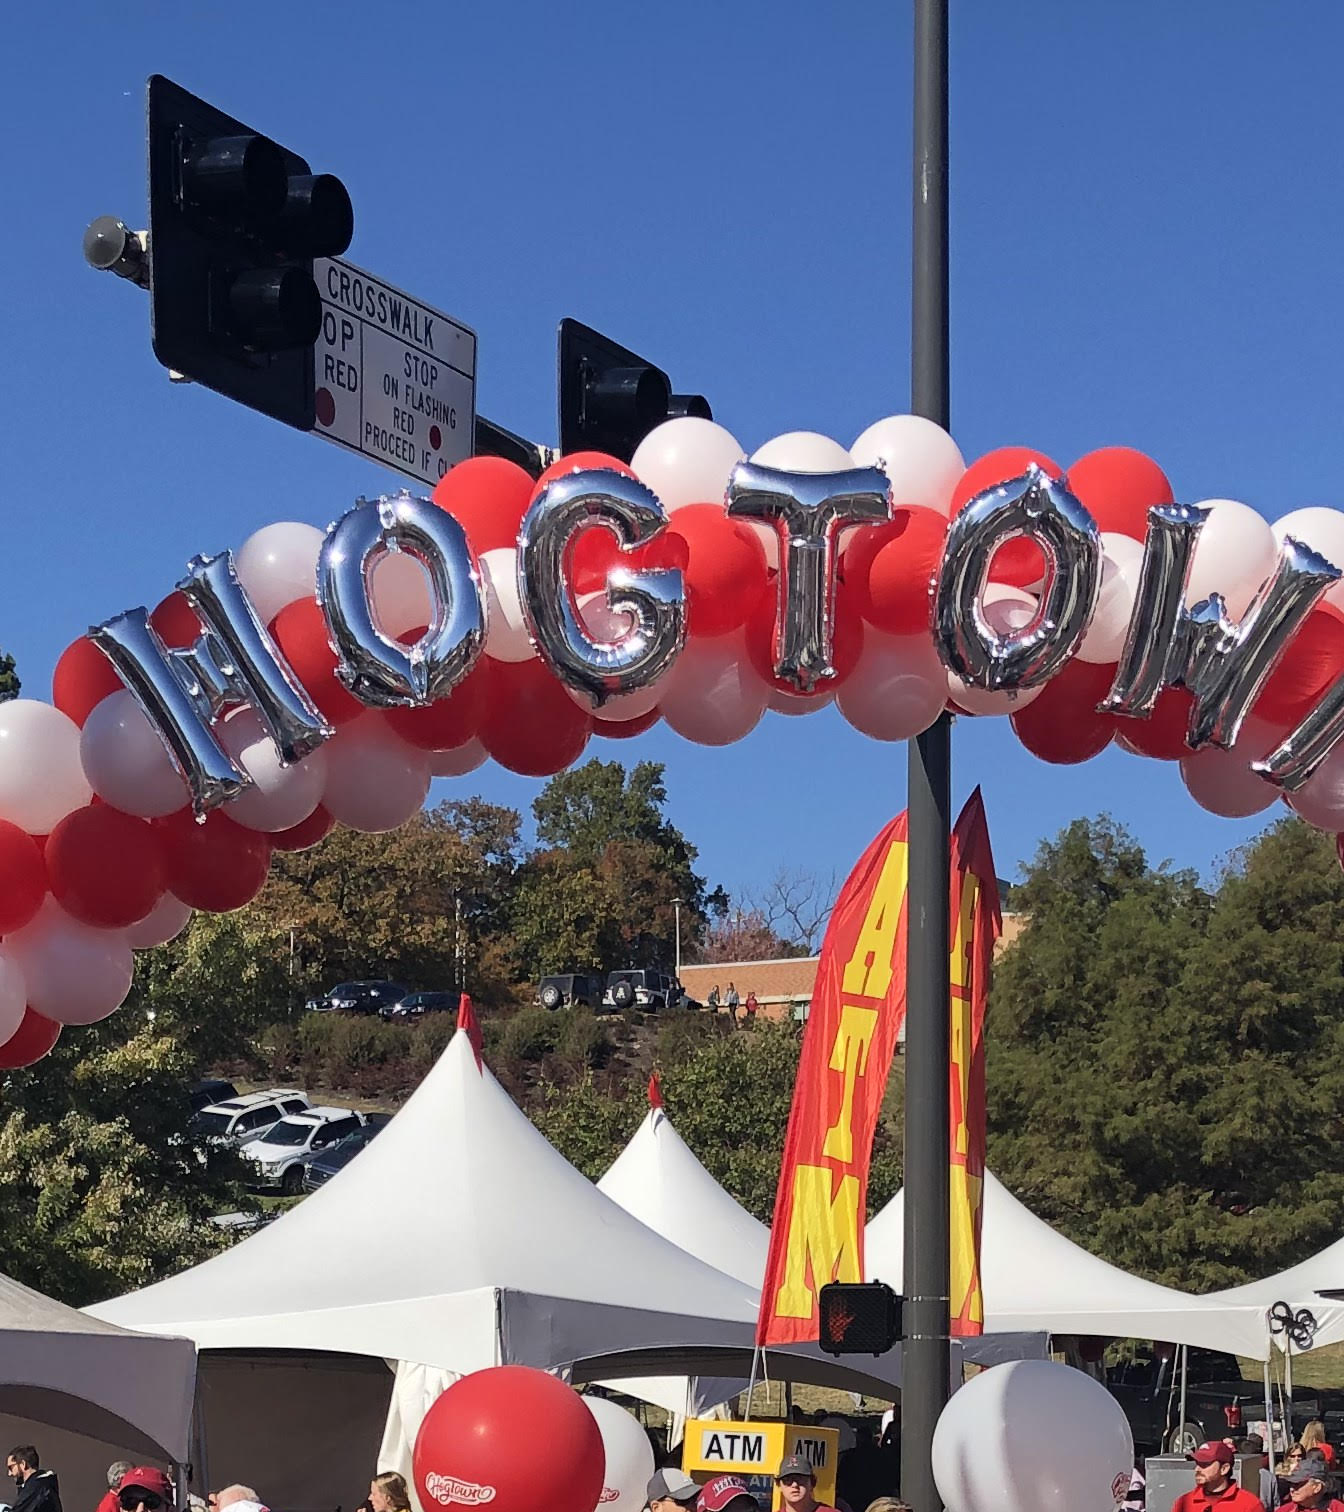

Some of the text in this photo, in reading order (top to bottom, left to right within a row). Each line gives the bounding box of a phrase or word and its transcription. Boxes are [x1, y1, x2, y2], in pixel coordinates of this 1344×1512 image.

[327, 265, 435, 350] CROSSWALK
[324, 354, 358, 393] RED
[404, 352, 438, 389] STOP
[383, 374, 456, 429] ON FLASHING
[393, 407, 415, 436] RED
[365, 422, 415, 464] PROCEED
[421, 454, 432, 472] IF
[704, 1434, 763, 1462] ATM
[795, 1440, 826, 1467] ATM
